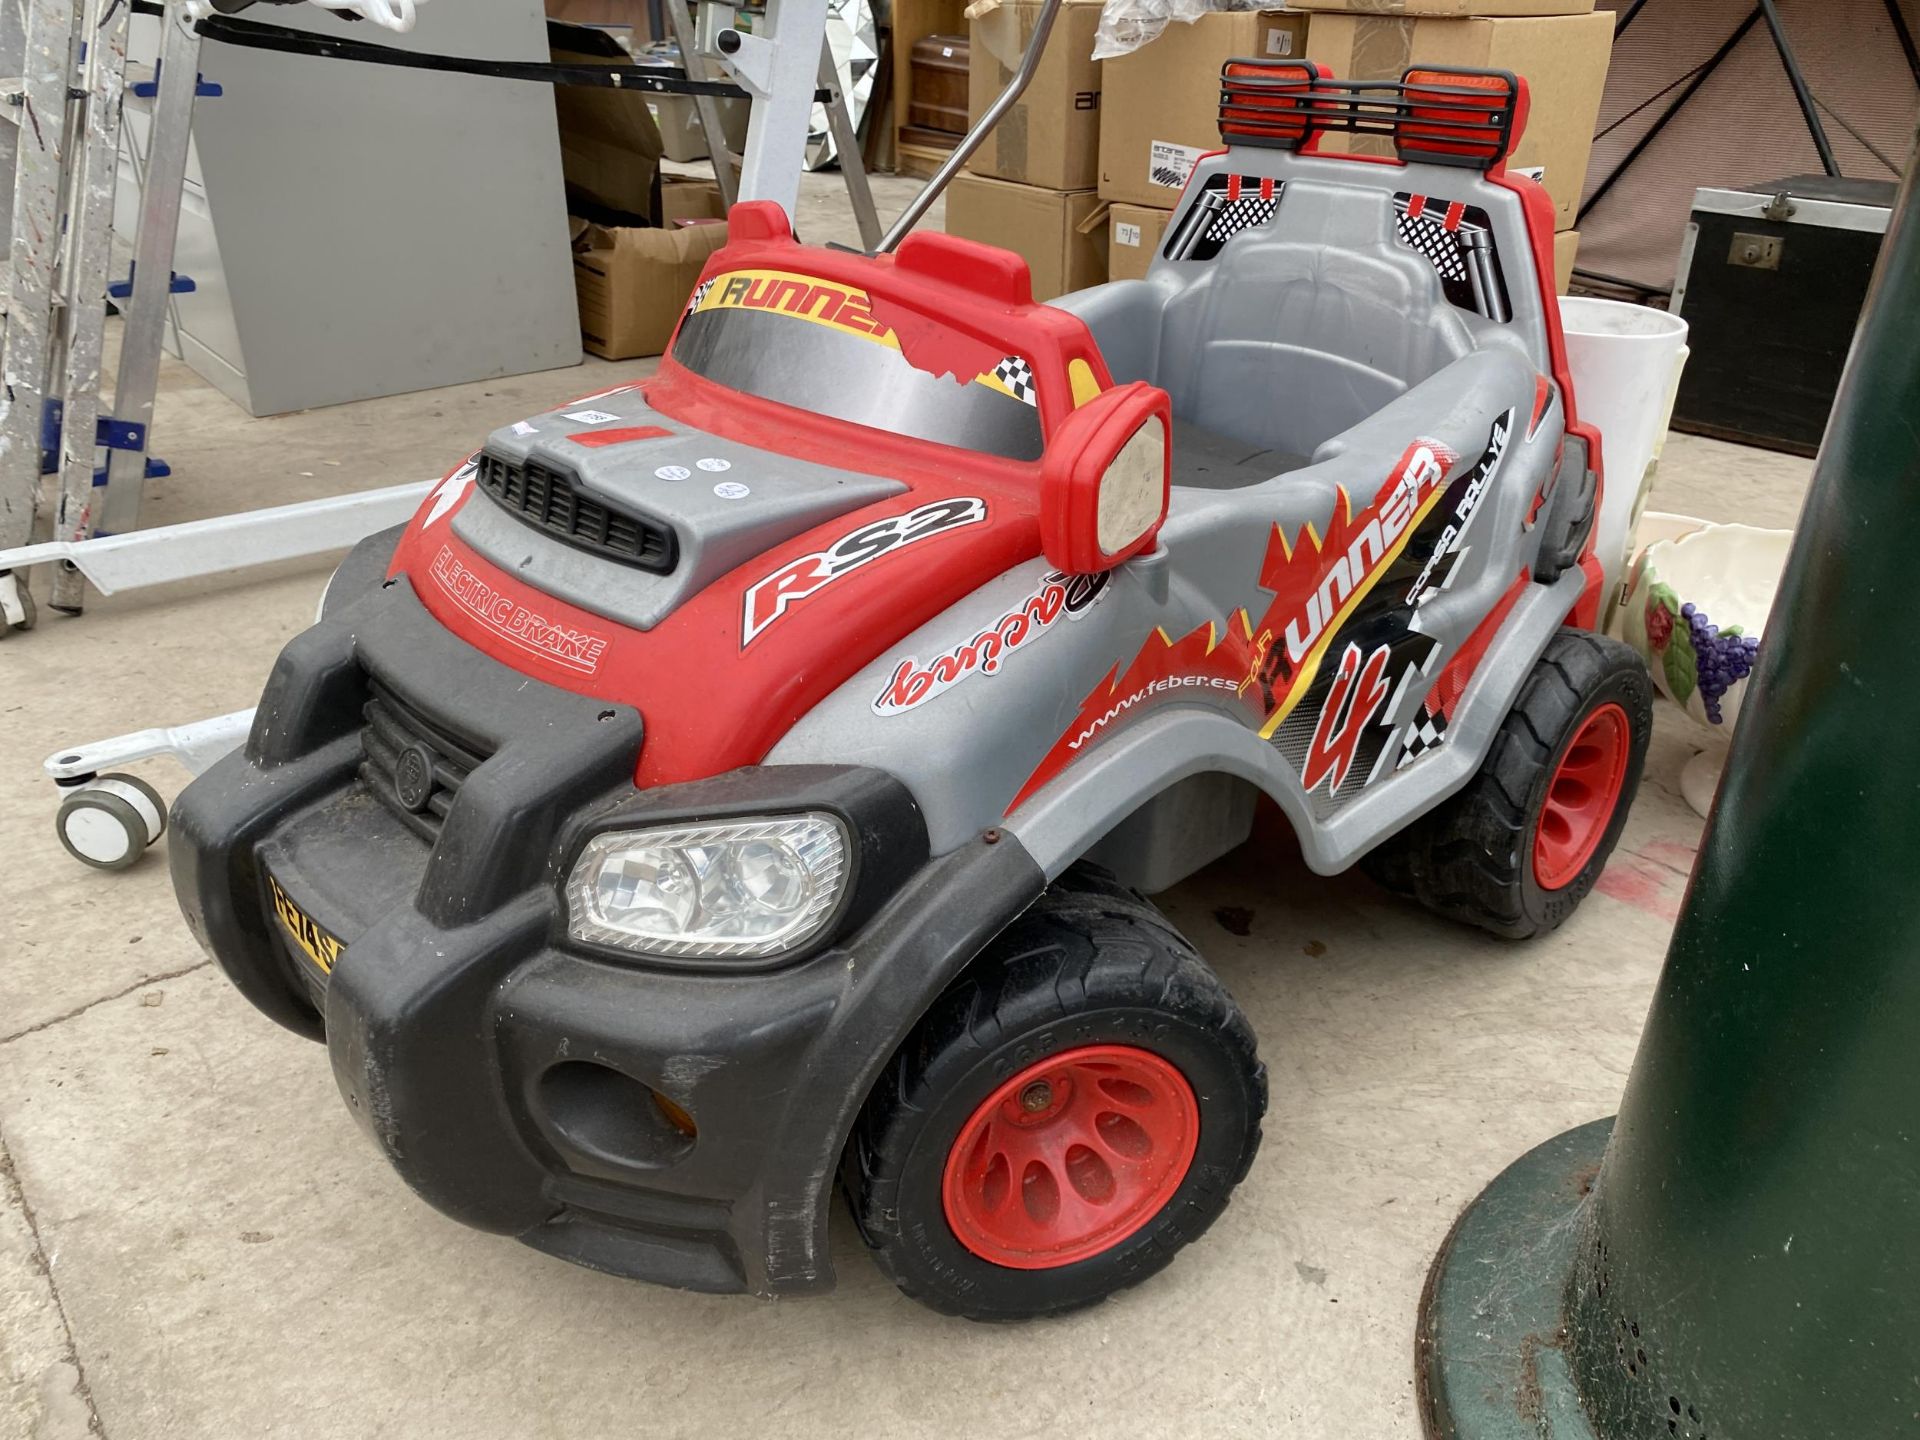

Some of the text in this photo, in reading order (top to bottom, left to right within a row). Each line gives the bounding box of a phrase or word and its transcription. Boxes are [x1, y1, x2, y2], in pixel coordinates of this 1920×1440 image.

[741, 496, 988, 652] RS2
[1405, 423, 1506, 606] CORSA RALLYE
[432, 544, 607, 665] ELECTRIC BRAKE
[1238, 628, 1272, 699] FOUR
[1068, 675, 1239, 749] www.feber.es
